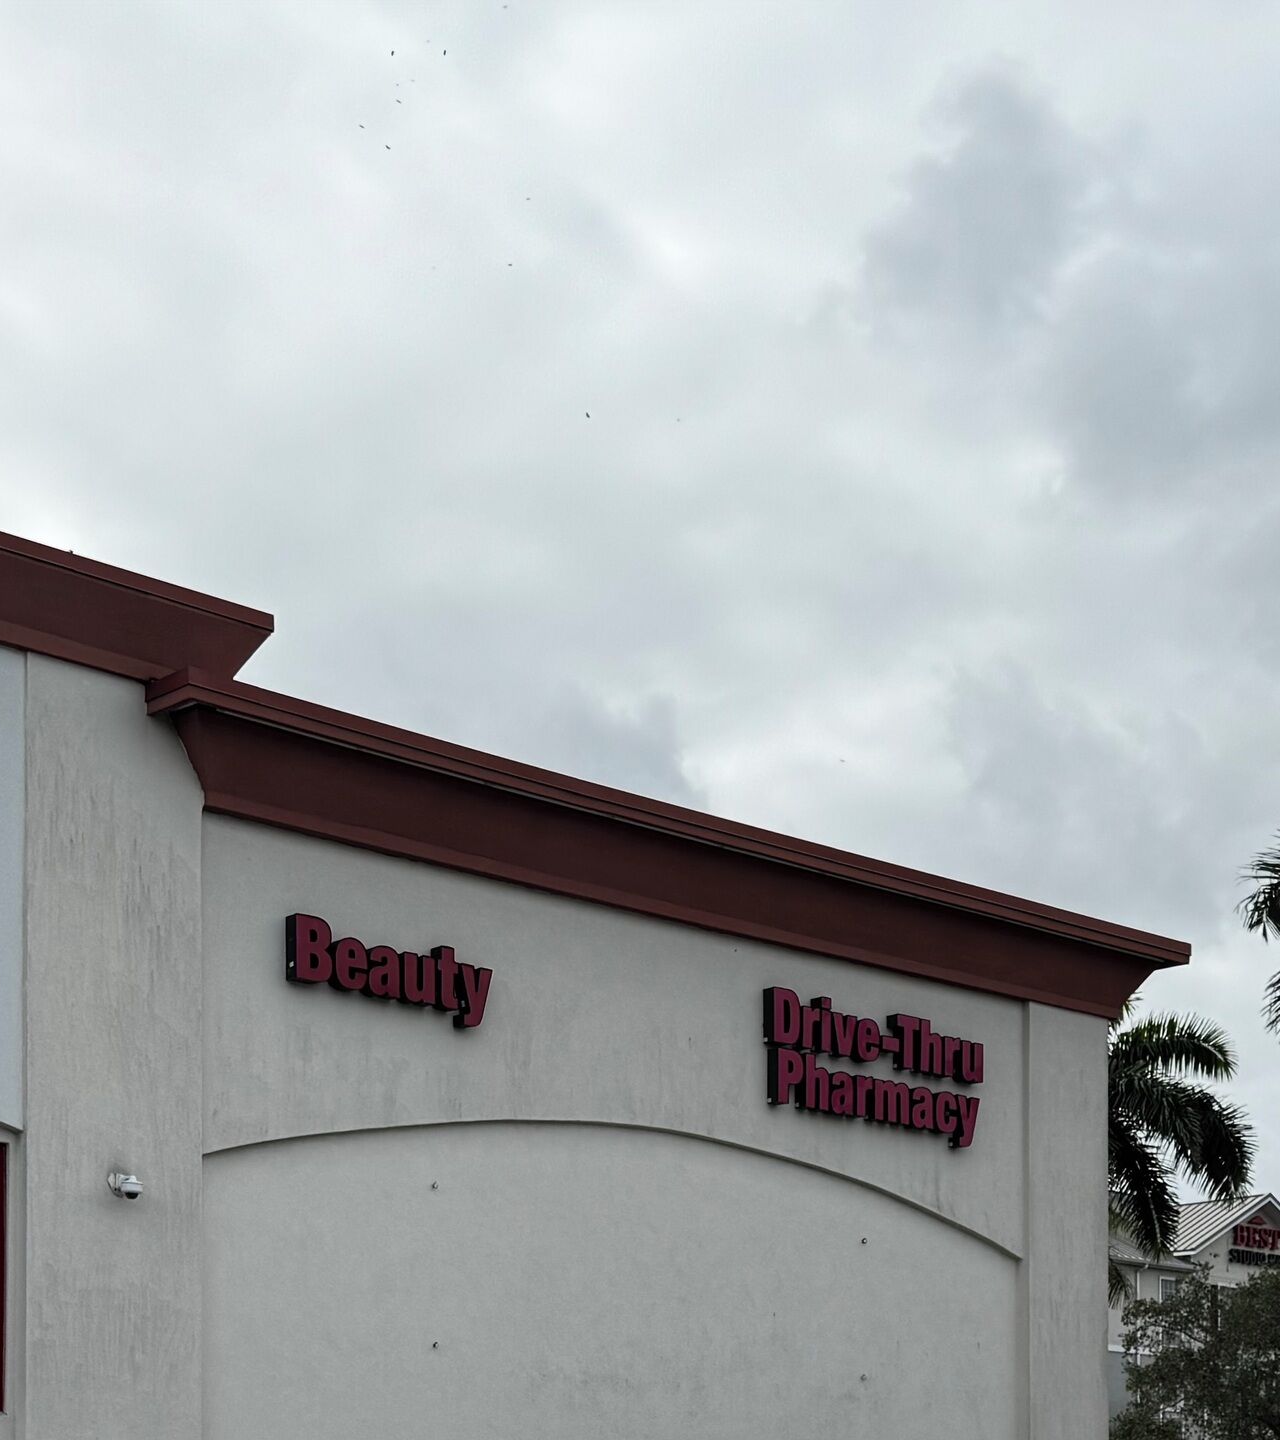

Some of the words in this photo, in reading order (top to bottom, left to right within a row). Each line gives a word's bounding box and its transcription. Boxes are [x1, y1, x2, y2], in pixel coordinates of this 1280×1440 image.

[285, 912, 493, 1029] Beauty
[762, 986, 984, 1085] Drive-Thru
[767, 1047, 980, 1148] Pharmacy
